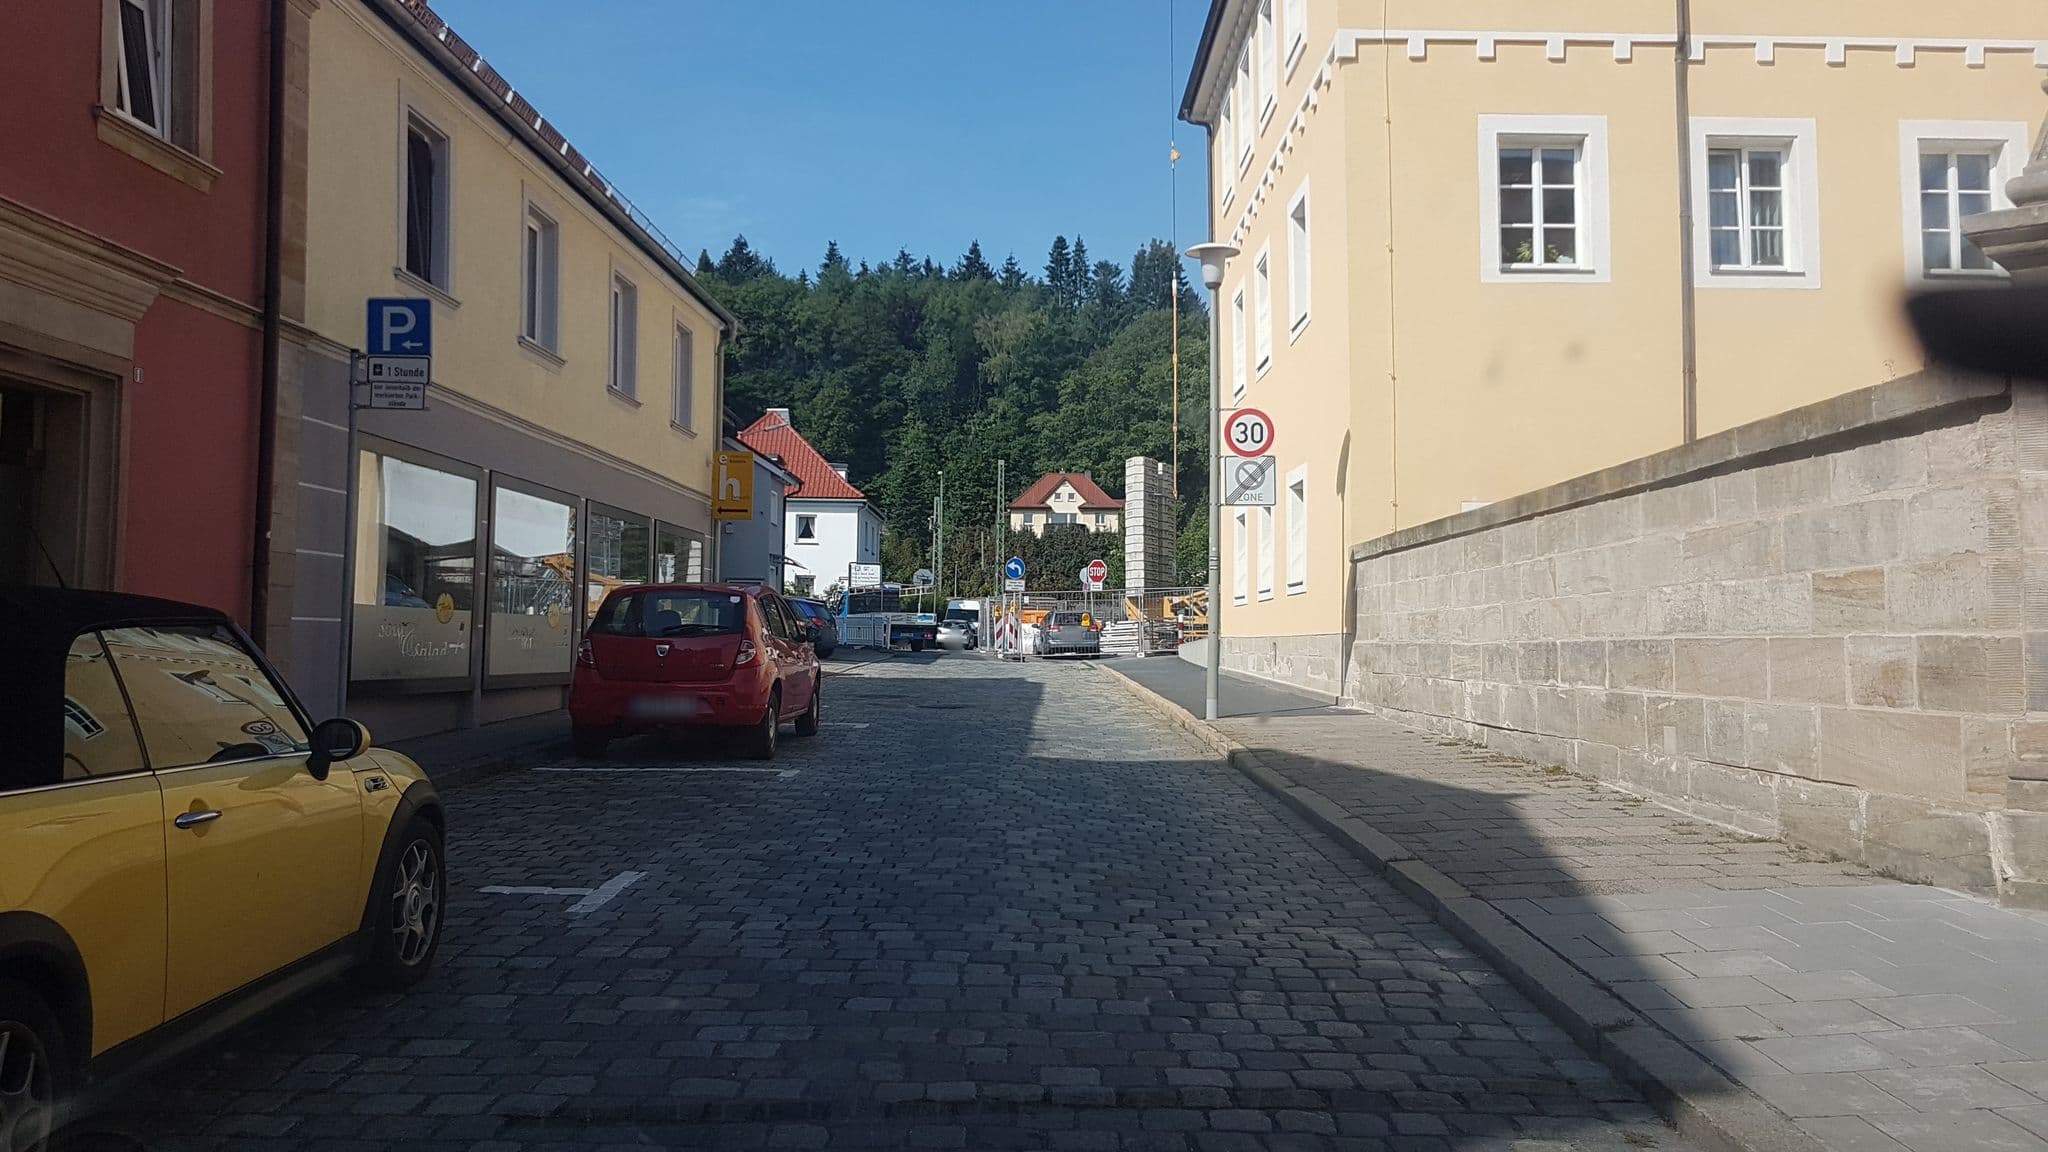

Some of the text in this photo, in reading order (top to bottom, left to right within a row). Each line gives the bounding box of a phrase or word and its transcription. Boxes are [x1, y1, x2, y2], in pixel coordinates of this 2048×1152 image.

[382, 306, 417, 352] P
[387, 367, 425, 377] 1 Stunde
[1235, 422, 1264, 444] 30
[1089, 567, 1106, 577] STOP
